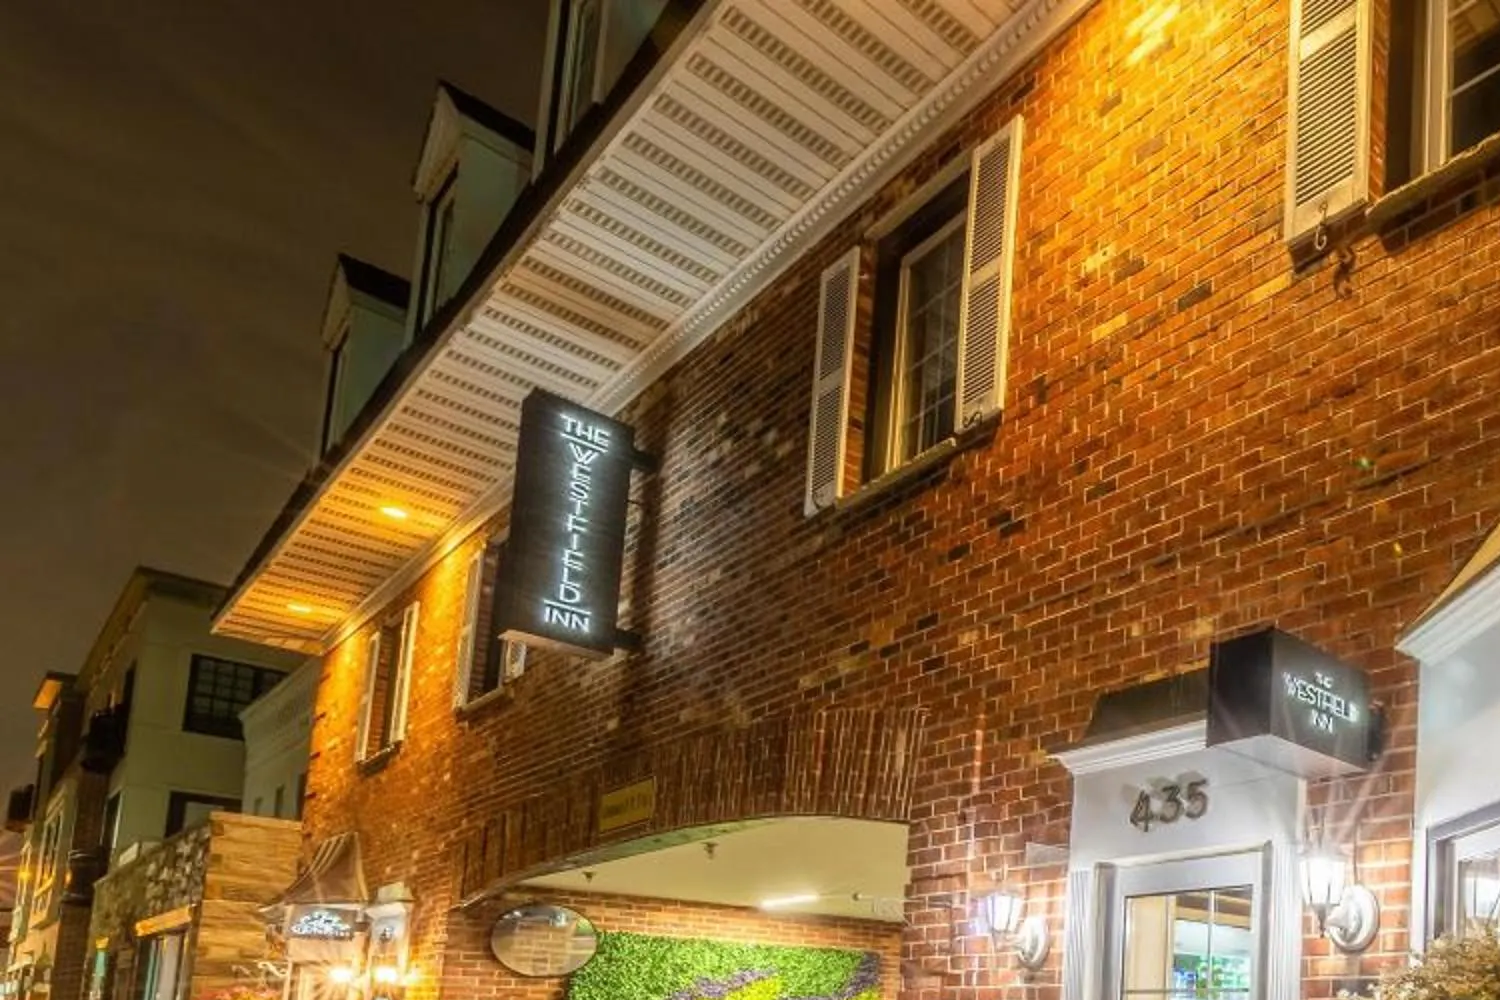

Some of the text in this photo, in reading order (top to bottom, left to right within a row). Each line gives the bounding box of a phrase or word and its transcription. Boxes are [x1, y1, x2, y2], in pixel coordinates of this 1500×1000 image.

[559, 413, 611, 447] THE
[559, 442, 600, 604] WESTFIELD
[544, 606, 591, 632] INN
[1129, 777, 1209, 833] 435
